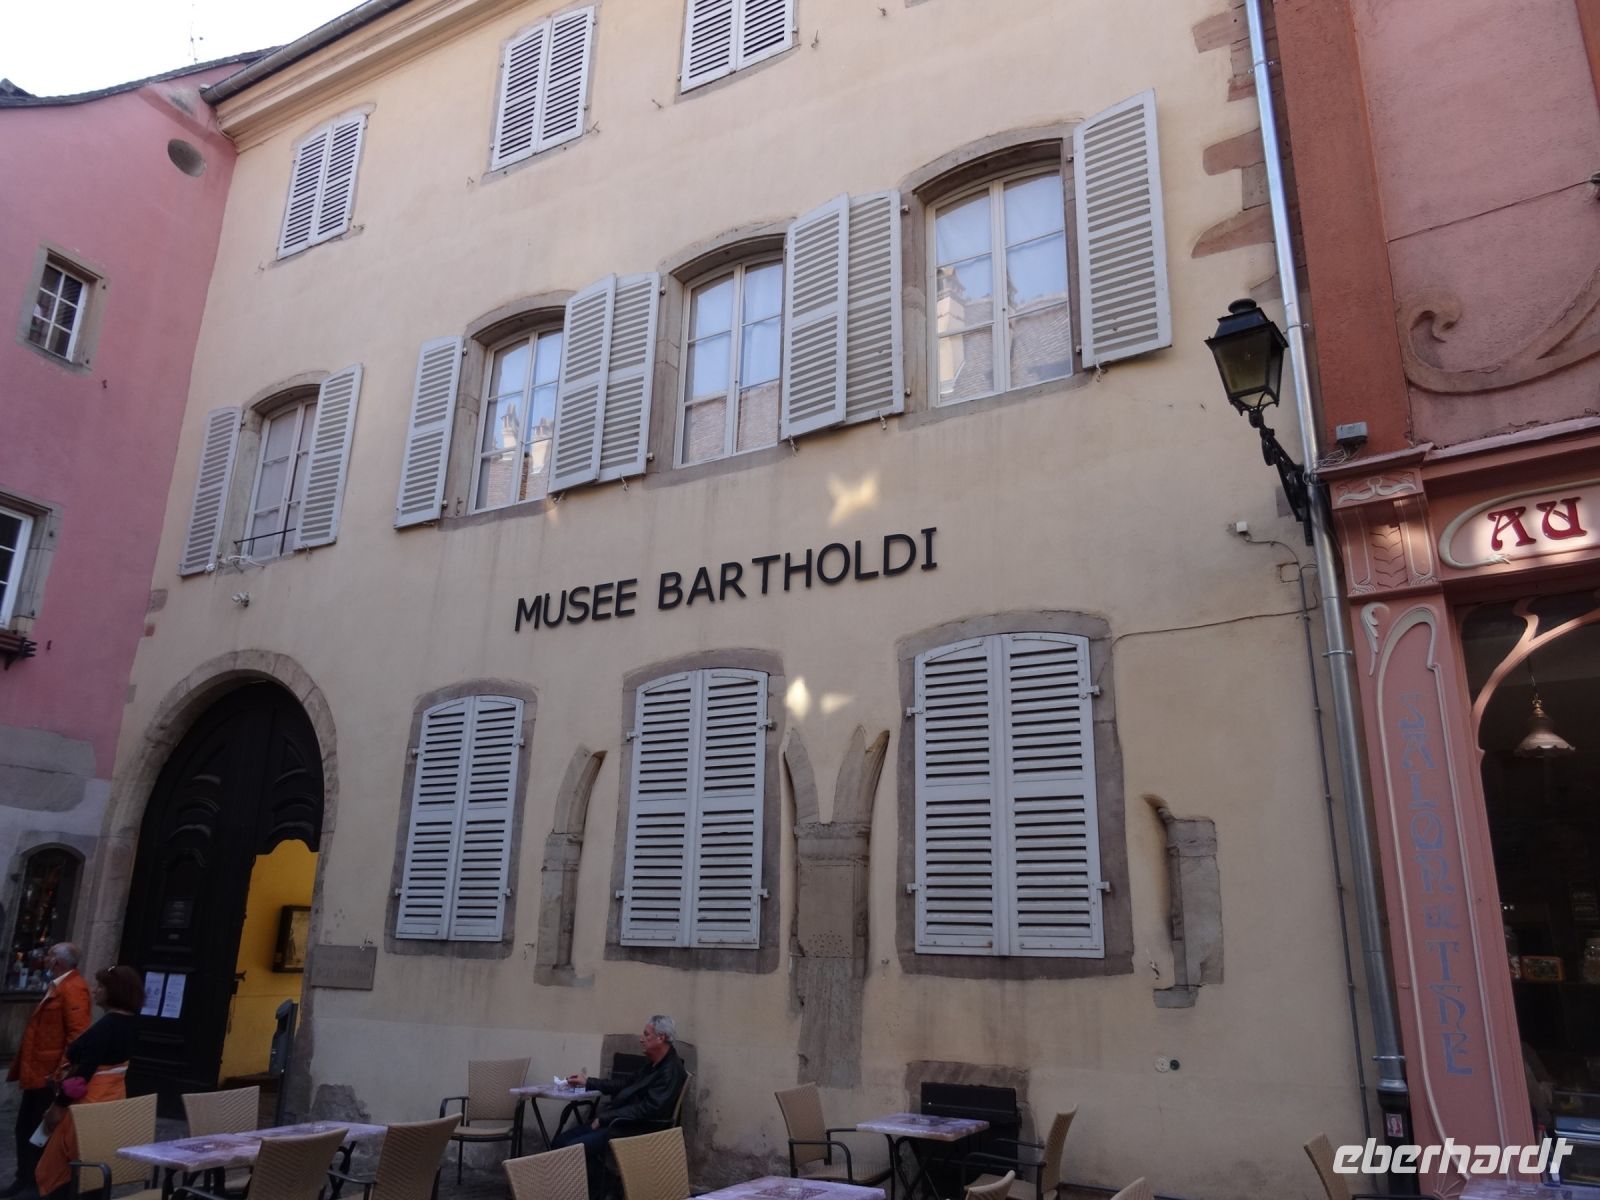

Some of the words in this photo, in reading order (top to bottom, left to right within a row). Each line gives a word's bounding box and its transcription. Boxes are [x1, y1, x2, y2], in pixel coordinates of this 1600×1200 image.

[1487, 496, 1588, 551] AU
[514, 578, 638, 632] MUSEE
[658, 527, 937, 610] BARTHOLDI
[1398, 691, 1454, 893] SALON
